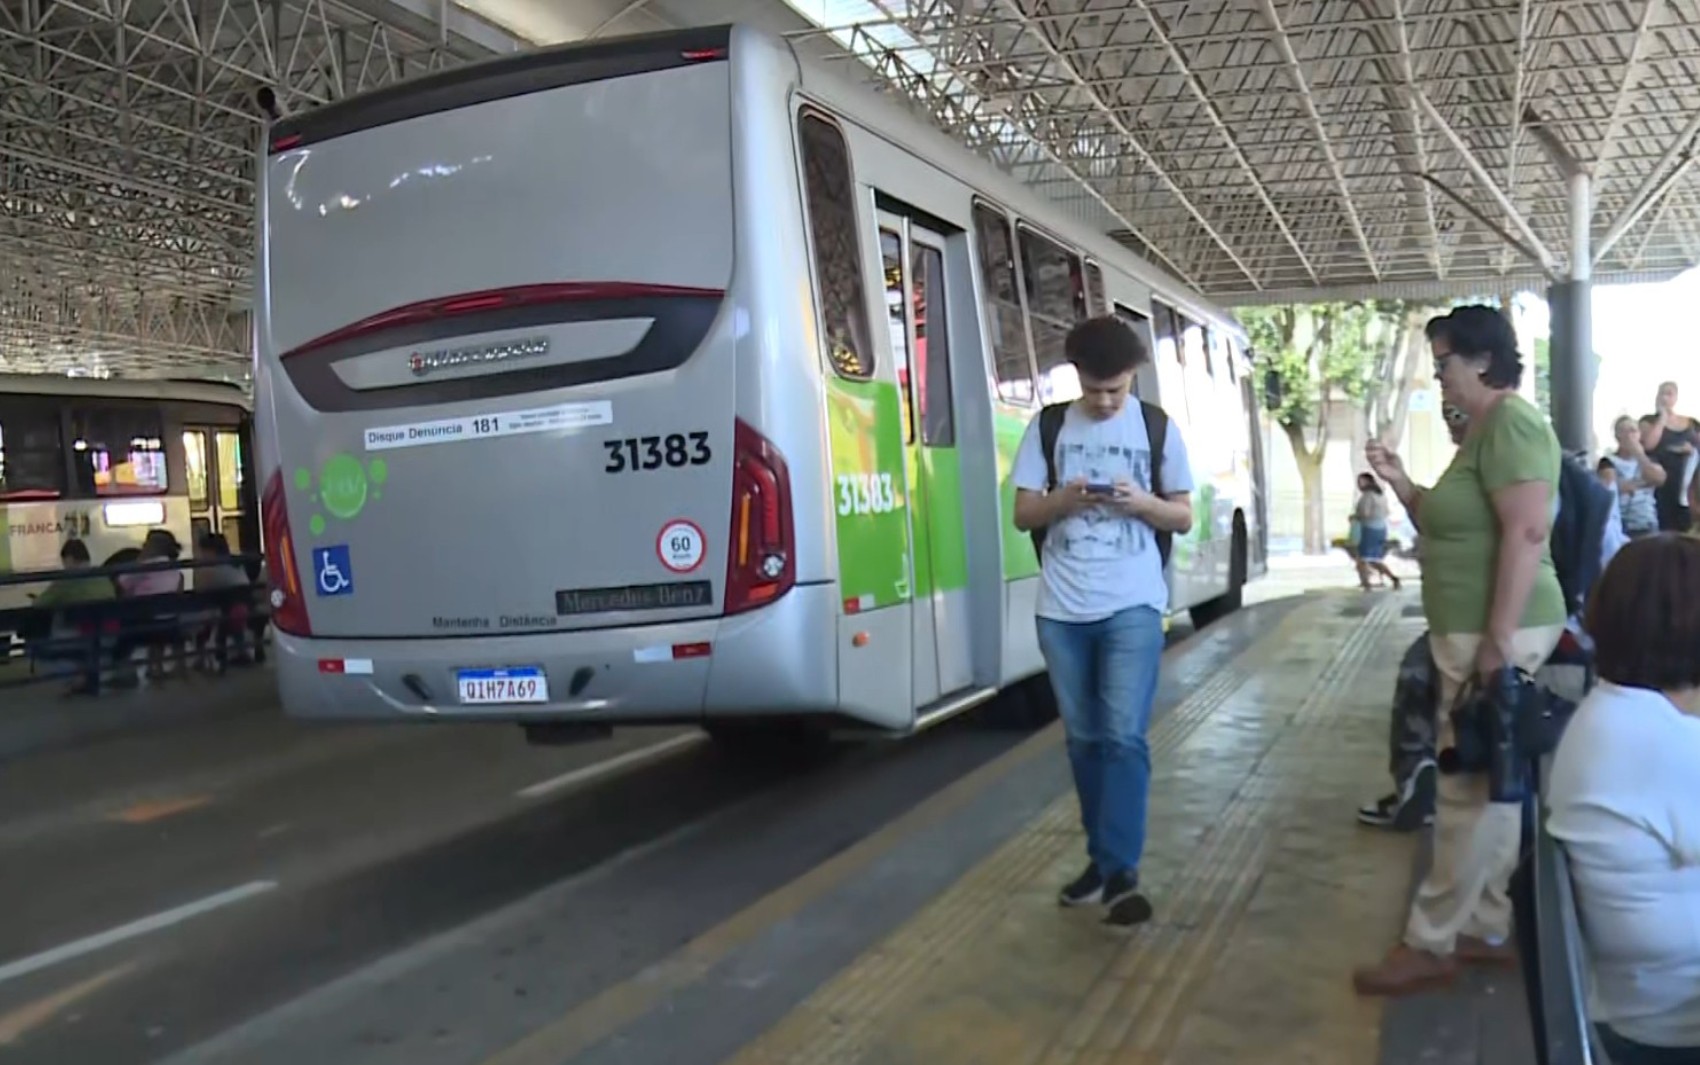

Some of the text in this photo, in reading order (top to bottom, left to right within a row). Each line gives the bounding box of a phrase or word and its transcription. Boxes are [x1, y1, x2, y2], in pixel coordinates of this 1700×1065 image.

[368, 430, 404, 443] Disque
[472, 417, 499, 434] 181
[603, 431, 712, 473] 31383
[838, 473, 893, 516] 31383
[670, 536, 691, 552] 60
[432, 616, 490, 628] Mantenha
